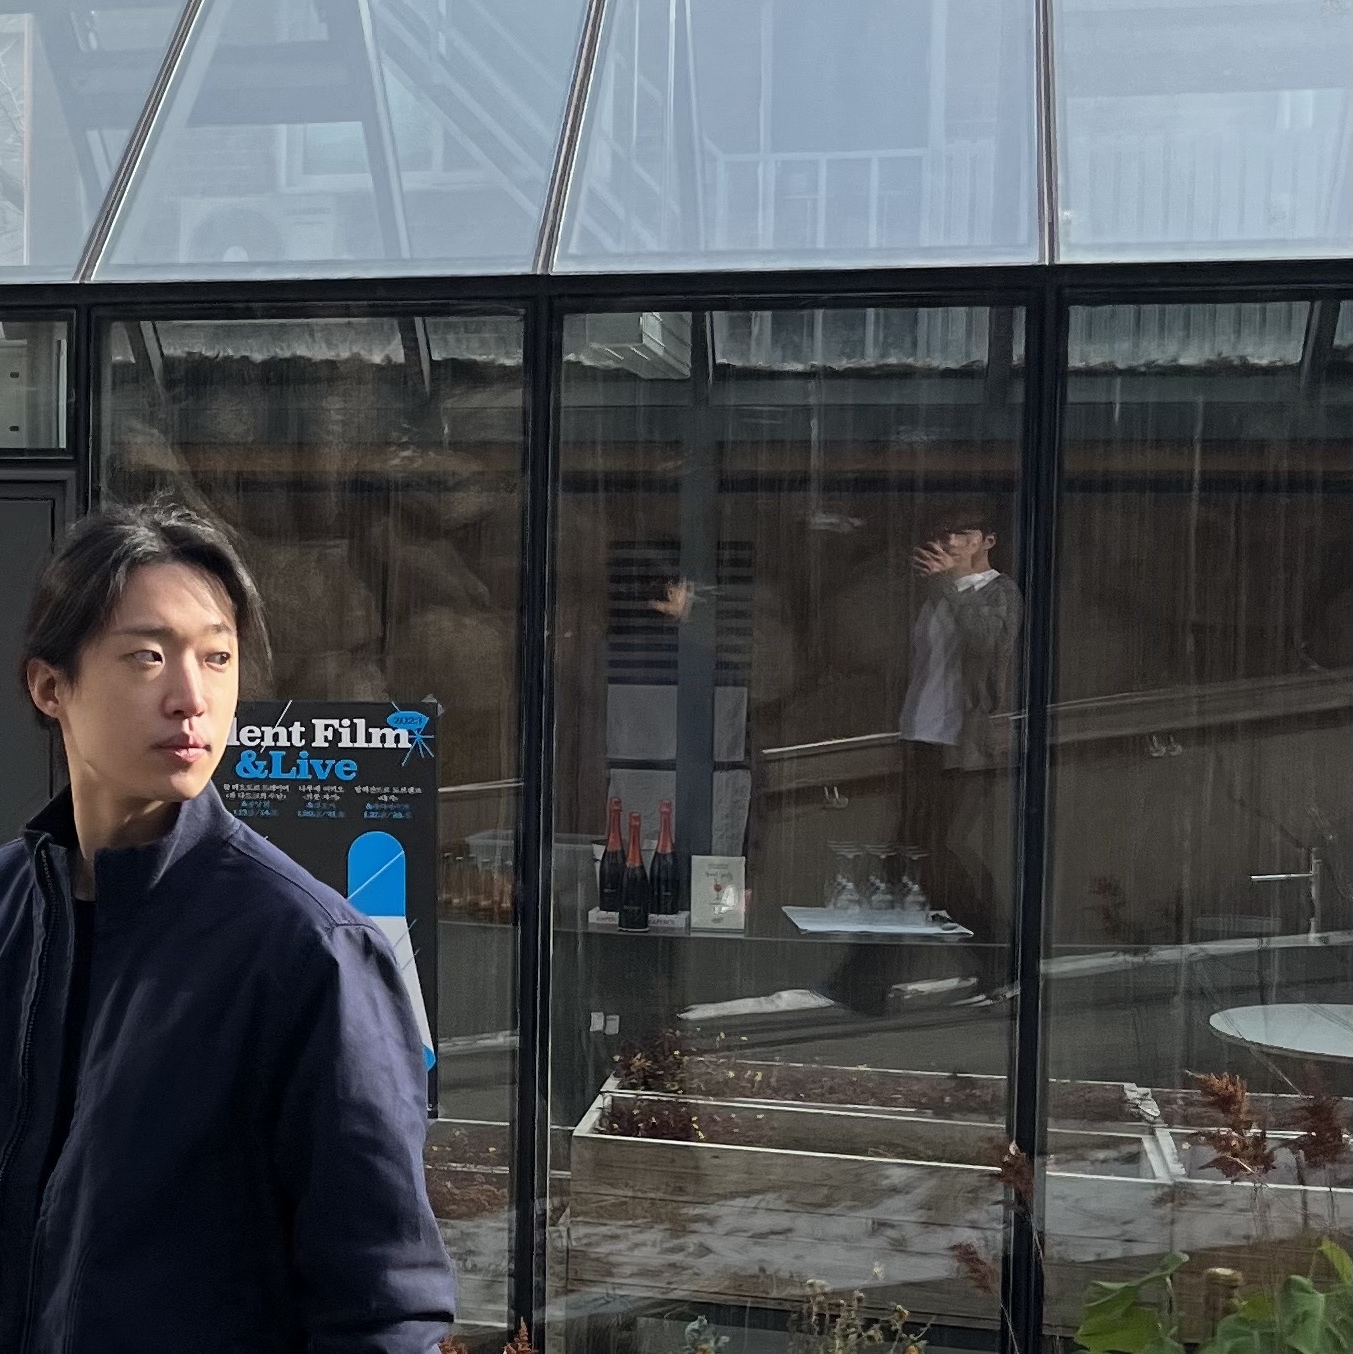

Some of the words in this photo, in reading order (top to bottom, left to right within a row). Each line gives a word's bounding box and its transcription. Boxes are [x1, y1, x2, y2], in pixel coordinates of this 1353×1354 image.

[227, 717, 306, 747] lent
[311, 718, 413, 749] Film
[235, 750, 358, 781] &Live
